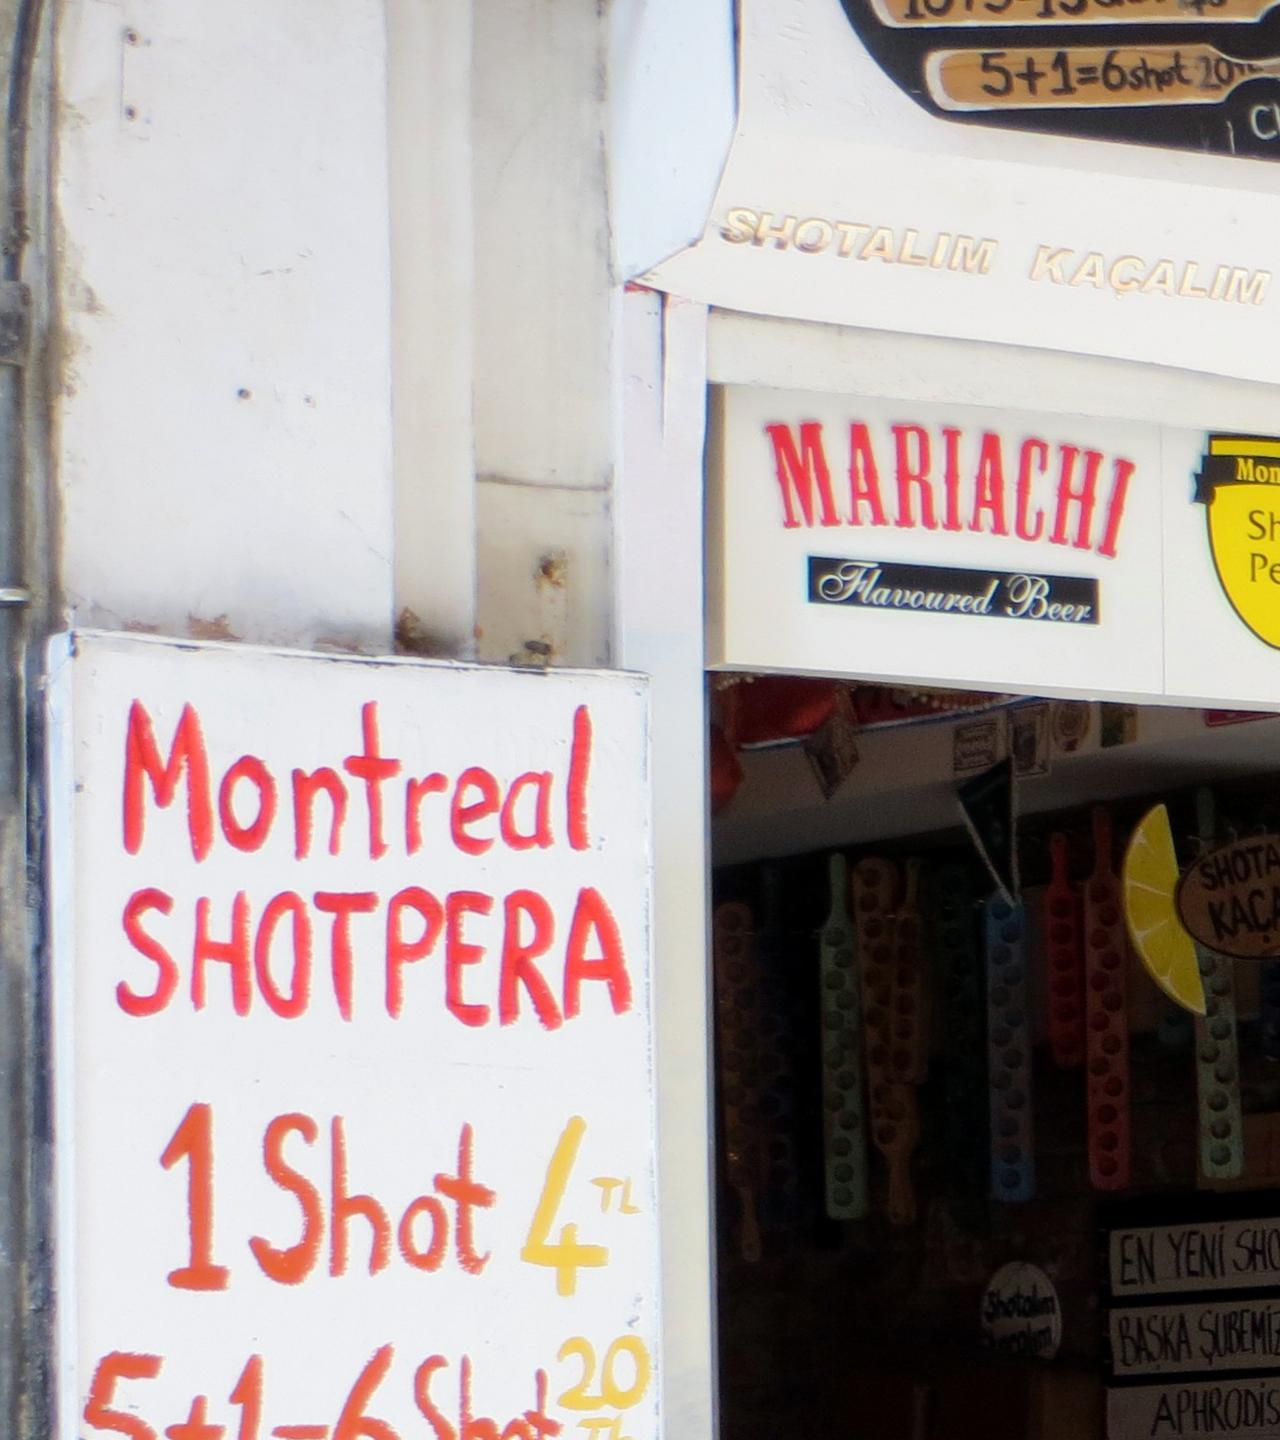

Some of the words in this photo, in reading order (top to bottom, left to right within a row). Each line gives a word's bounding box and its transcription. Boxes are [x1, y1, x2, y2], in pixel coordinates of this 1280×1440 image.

[720, 207, 998, 276] SHOTALIM
[1029, 244, 1273, 306] KAÇALIM
[765, 420, 1136, 561] MARIACHI
[817, 561, 995, 616] Flavoured
[1004, 573, 1093, 625] Beer
[122, 698, 593, 863] Montreal
[116, 886, 634, 1032] SHOTPERA
[160, 1102, 230, 1292] 1
[248, 1111, 498, 1286] Shot
[521, 1115, 610, 1298] 4
[590, 1176, 644, 1215] TL
[1120, 1234, 1157, 1286] EN
[1168, 1226, 1228, 1279] YENİ
[557, 1334, 653, 1411] 20
[1118, 1314, 1193, 1369] BAŞKA
